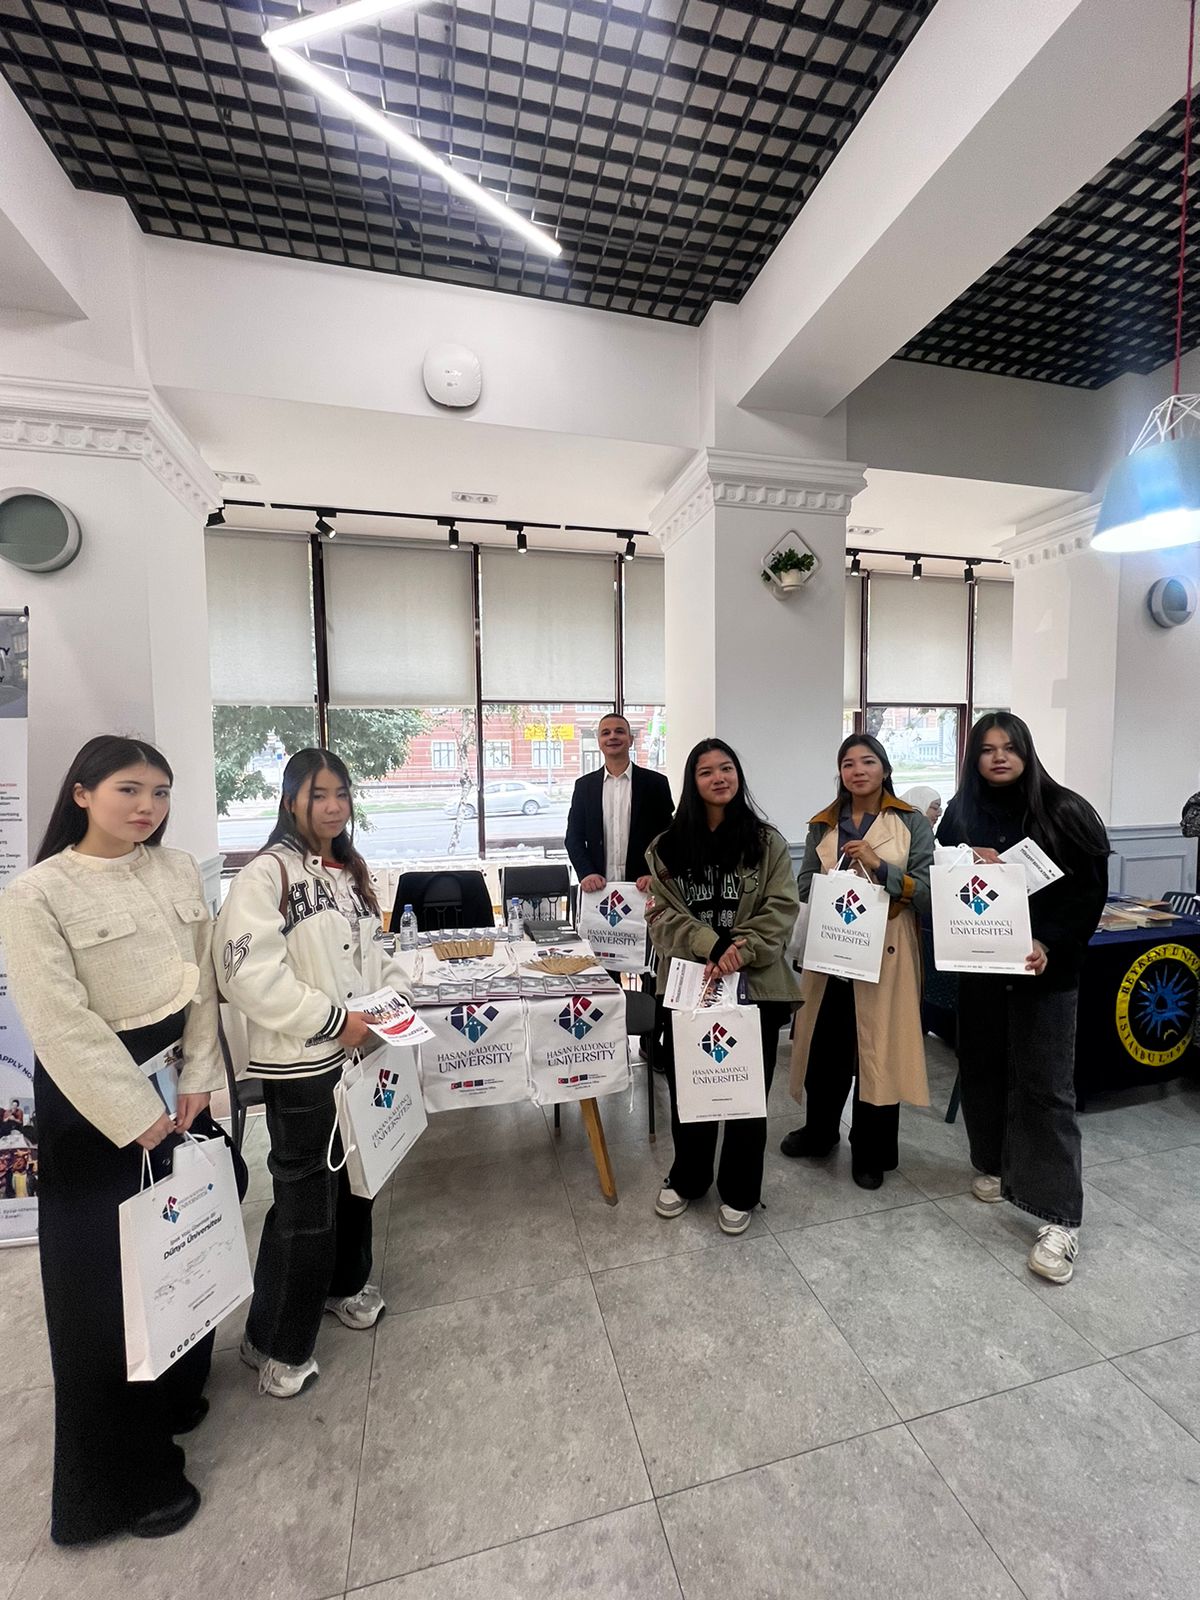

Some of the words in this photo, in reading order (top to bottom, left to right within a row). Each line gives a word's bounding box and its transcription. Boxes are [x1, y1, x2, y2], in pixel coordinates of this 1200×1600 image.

[587, 935, 638, 946] UNIVERSITY
[223, 933, 252, 983] 93
[437, 1051, 467, 1062] HASAN
[468, 1043, 513, 1056] KALYONCU
[546, 1047, 572, 1059] HASAN
[573, 1042, 616, 1052] KALYONCU
[547, 1049, 616, 1067] UNIVERSITY
[438, 1052, 513, 1074] UNIVERSITY
[163, 1240, 186, 1260] Dünya
